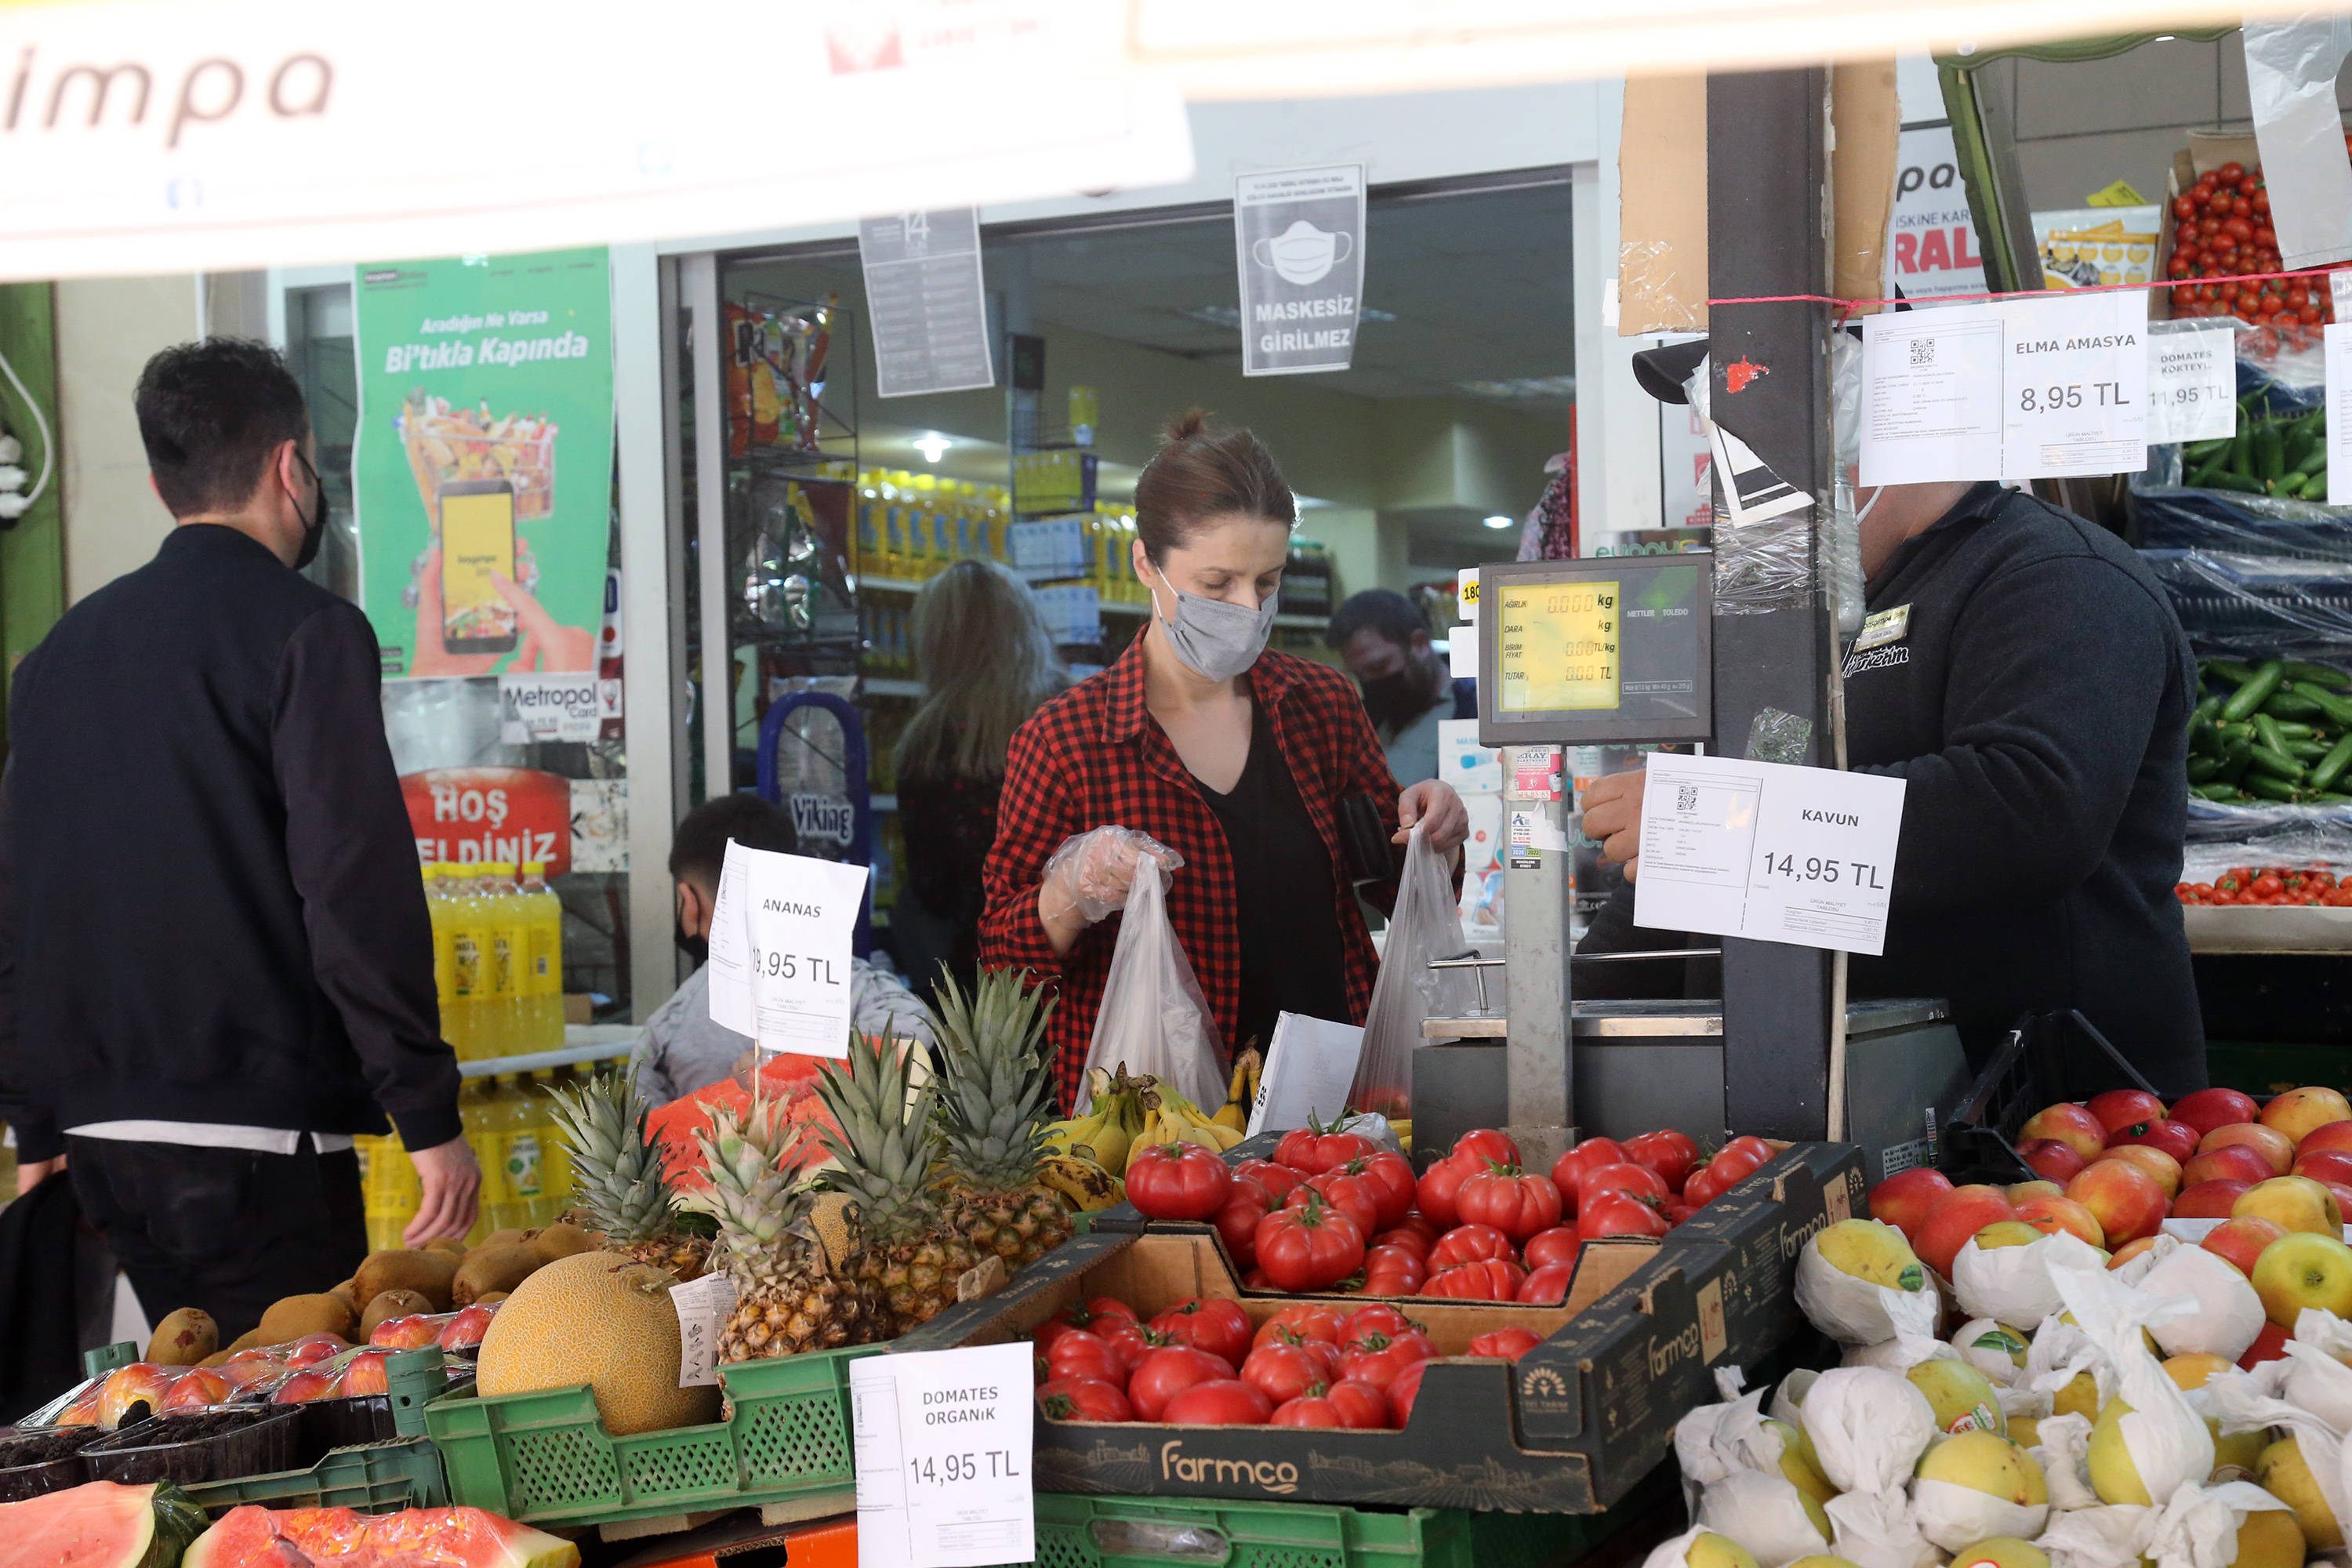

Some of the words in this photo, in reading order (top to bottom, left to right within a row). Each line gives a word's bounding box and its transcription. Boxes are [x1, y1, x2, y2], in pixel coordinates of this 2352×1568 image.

[1896, 162, 1955, 202] pa
[1895, 226, 1983, 274] RAL
[1256, 294, 1354, 321] MASKESİZ
[485, 312, 505, 328] Ne
[508, 310, 549, 326] Varsa
[477, 330, 590, 368] Kapında
[1260, 328, 1351, 353] GİRİLMEZ
[2016, 340, 2060, 354] ELMA
[2065, 334, 2136, 351] AMASYA
[2160, 350, 2213, 364] DOMATES
[2020, 385, 2083, 414] 8,95
[2092, 382, 2131, 406] TL
[2148, 387, 2199, 407] 11,95
[2202, 385, 2229, 401] TL
[1597, 593, 1613, 609] kg
[1627, 609, 1656, 618] METTLER
[1662, 608, 1689, 616] TOLEDO
[1504, 625, 1523, 633] DARA
[1598, 619, 1611, 633] kg
[1594, 642, 1615, 653] TL/kg
[1504, 671, 1525, 681] TUTAR
[1599, 666, 1613, 681] TL
[506, 682, 597, 710] Metropol
[568, 706, 597, 718] Card
[430, 784, 509, 830] HOŞ
[791, 795, 853, 844] Viking
[1802, 809, 1860, 827] KAVUN
[1765, 851, 1840, 883] 14,95
[1850, 862, 1885, 890] TL
[762, 898, 822, 918] ANANAS
[752, 946, 797, 979] 19,95
[807, 956, 840, 985] TL
[923, 1386, 999, 1406] DOMATES
[910, 1453, 977, 1487] 14,95
[985, 1450, 1020, 1479] TL
